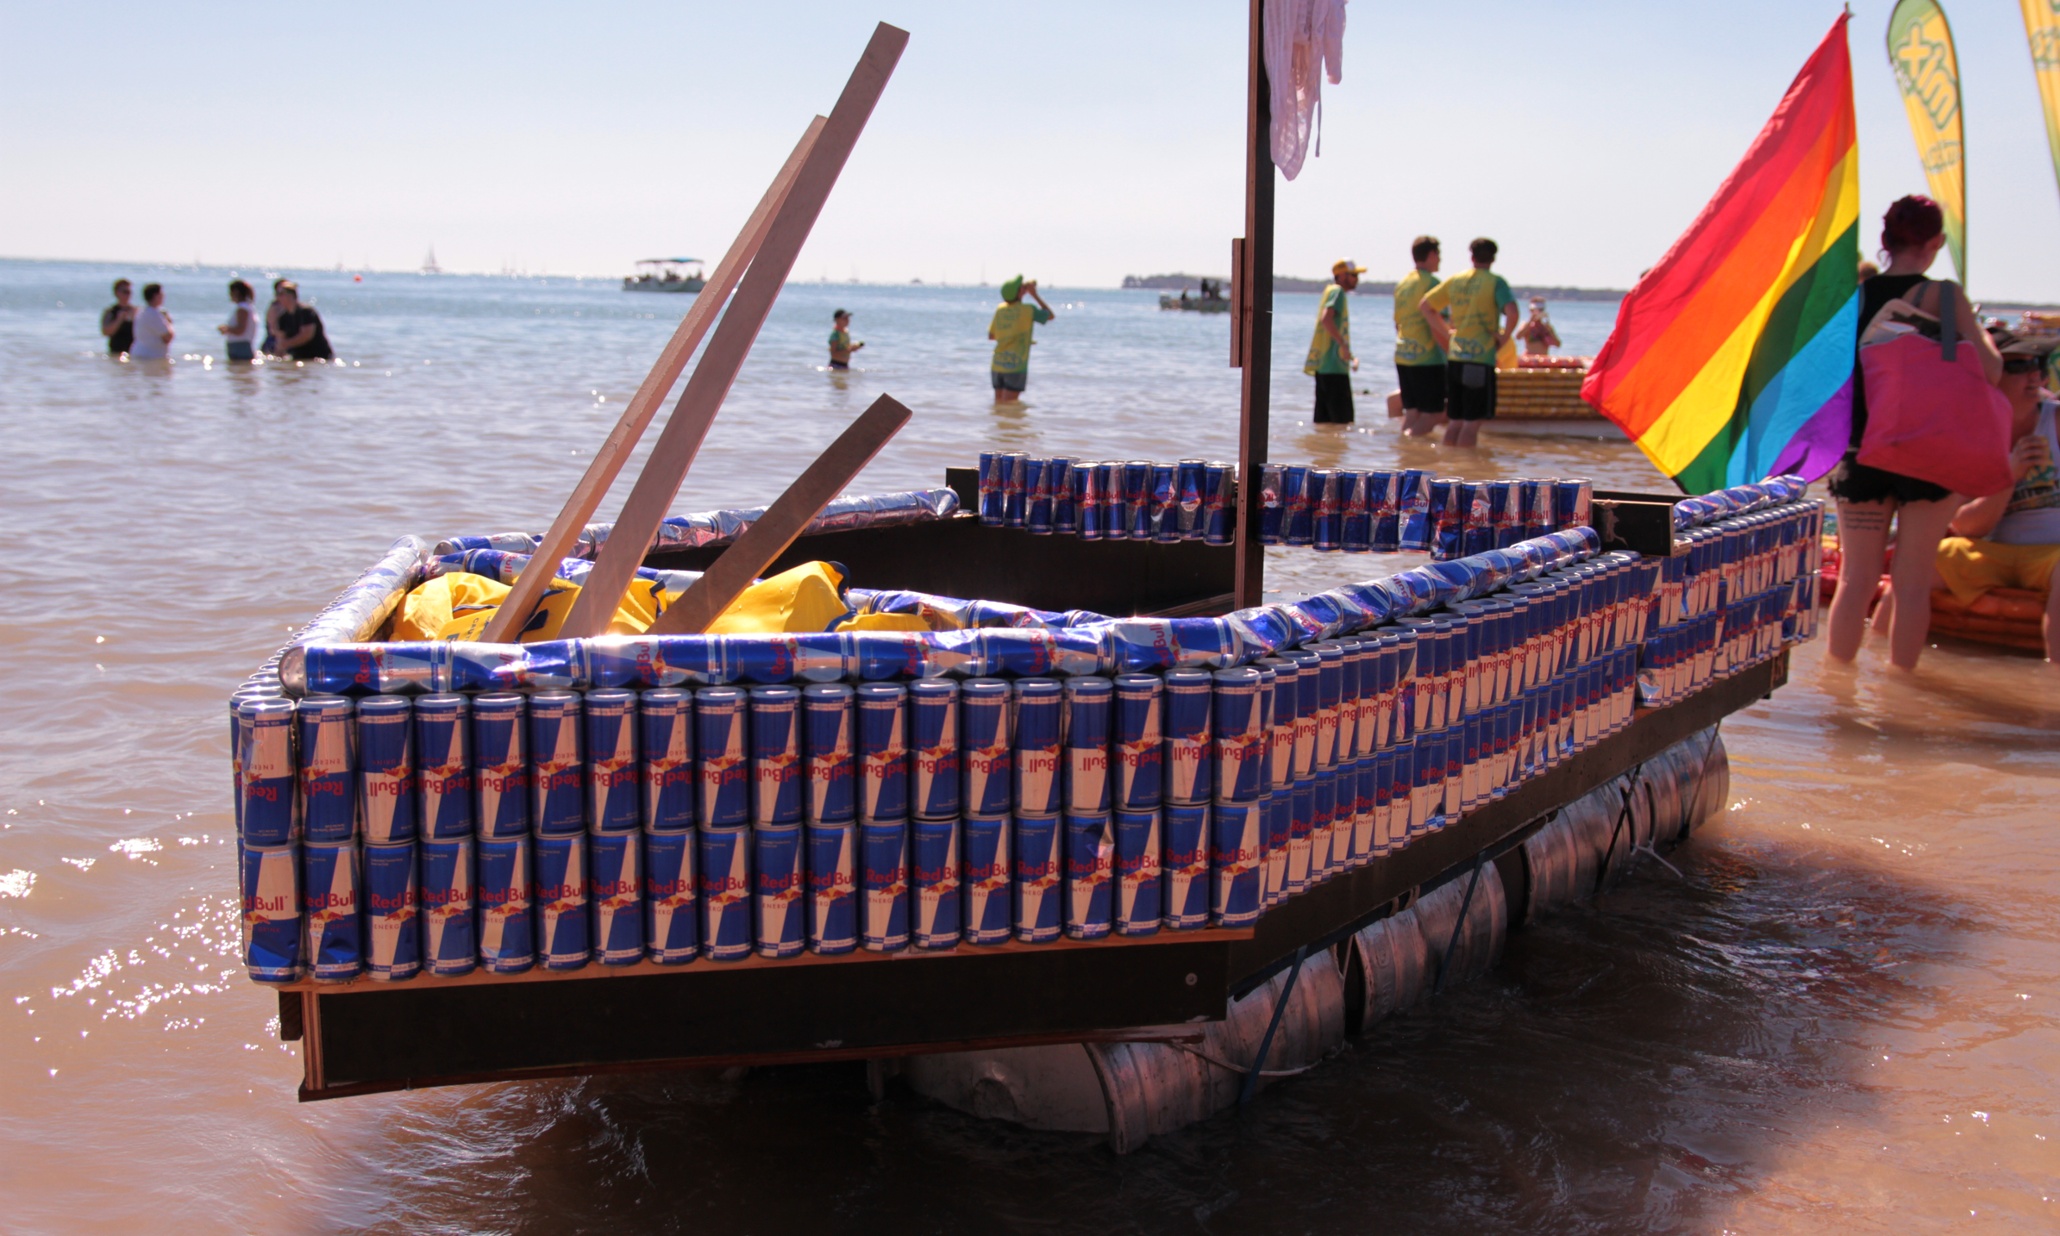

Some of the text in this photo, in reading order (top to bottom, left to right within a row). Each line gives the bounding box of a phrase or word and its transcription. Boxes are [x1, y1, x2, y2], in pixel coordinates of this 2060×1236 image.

[355, 653, 370, 683] Red
[1417, 684, 1432, 696] Bul
[1320, 716, 1338, 729] Bul
[1174, 746, 1200, 761] Bull
[1029, 758, 1055, 773] Bull
[311, 780, 344, 797] Red
[370, 780, 399, 797] Bull
[1166, 848, 1193, 863] Red
[1237, 844, 1258, 861] Bull
[1017, 860, 1045, 876] Red
[1067, 858, 1095, 873] Red
[760, 872, 789, 888] Red
[865, 868, 895, 883] Red
[254, 895, 284, 912] Bull
[328, 889, 357, 907] Bull
[370, 892, 402, 909] Red
